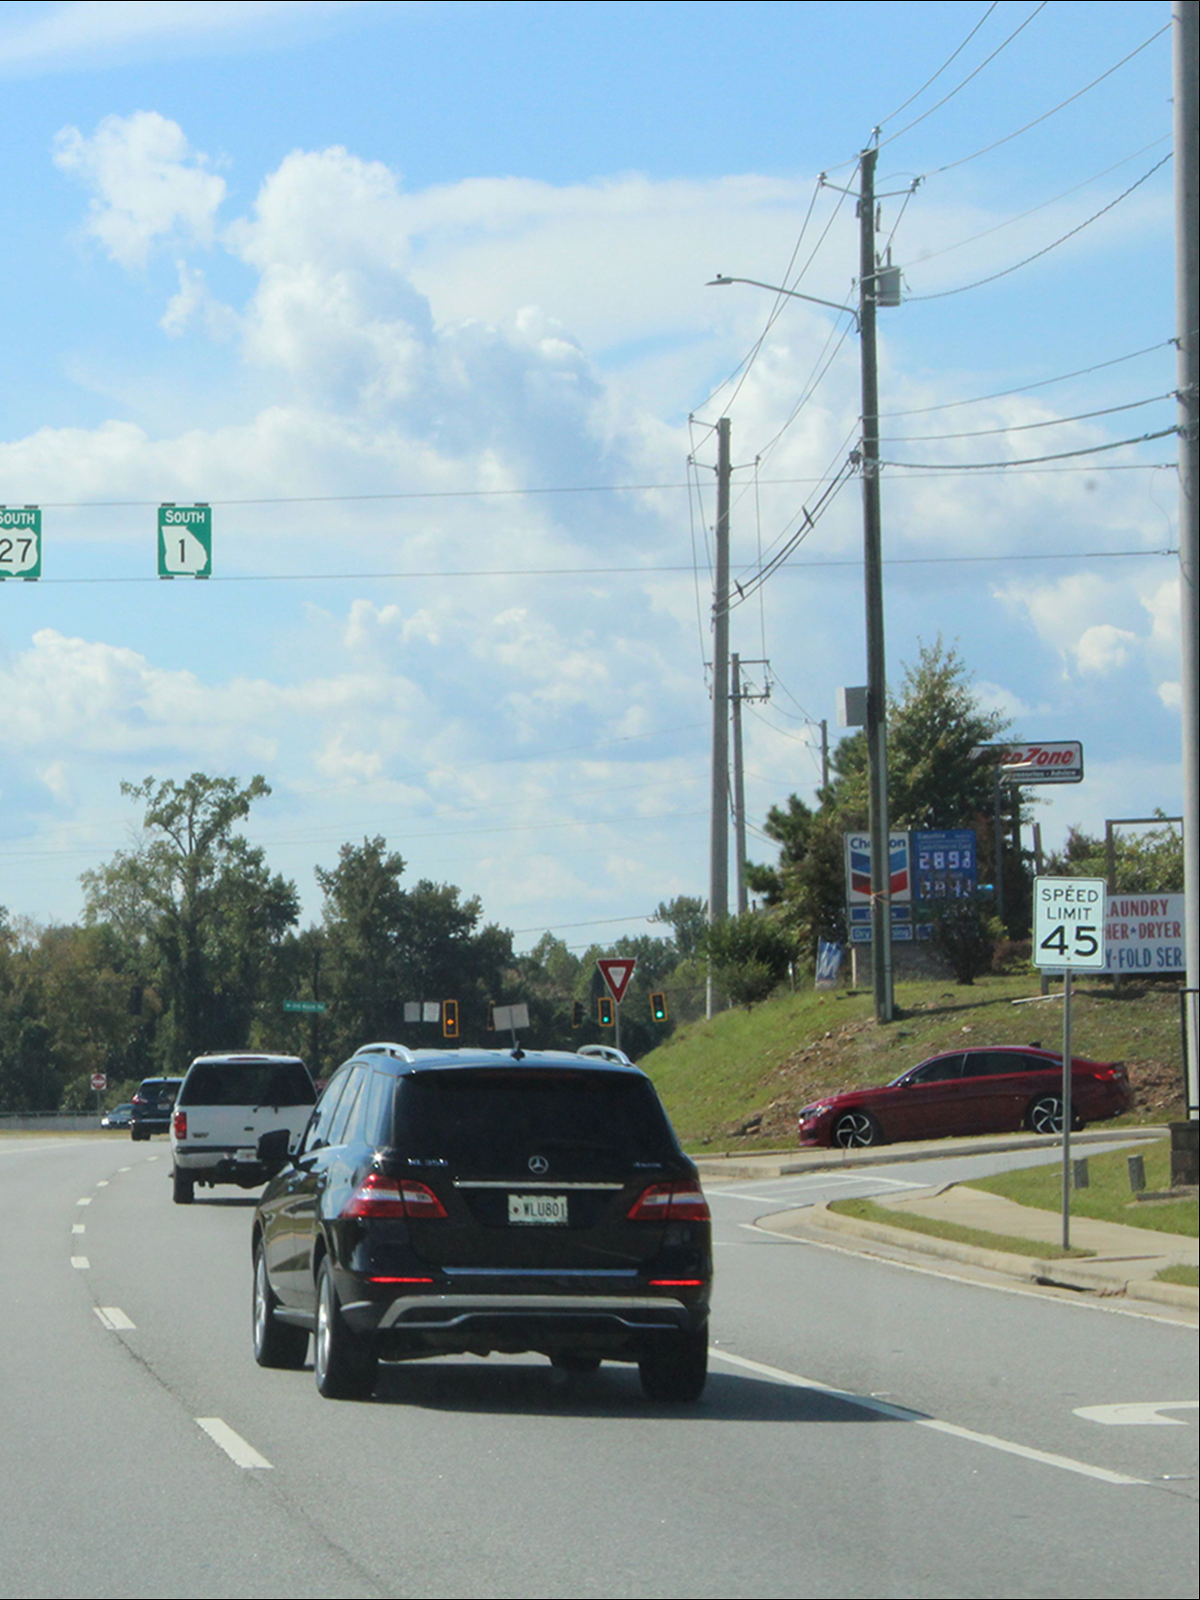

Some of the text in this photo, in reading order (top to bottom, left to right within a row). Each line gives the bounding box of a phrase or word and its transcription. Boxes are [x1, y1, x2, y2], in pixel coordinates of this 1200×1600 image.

[165, 510, 205, 523] SOUTH
[178, 539, 186, 563] 1
[850, 837, 906, 849] Chon
[1042, 888, 1099, 902] SPEED
[1047, 907, 1092, 920] LIMIT
[1106, 899, 1169, 917] AUNDRY
[1138, 921, 1181, 939] DRYER
[1040, 925, 1098, 957] 45
[1119, 948, 1152, 968] FOLD
[1156, 947, 1184, 968] SER
